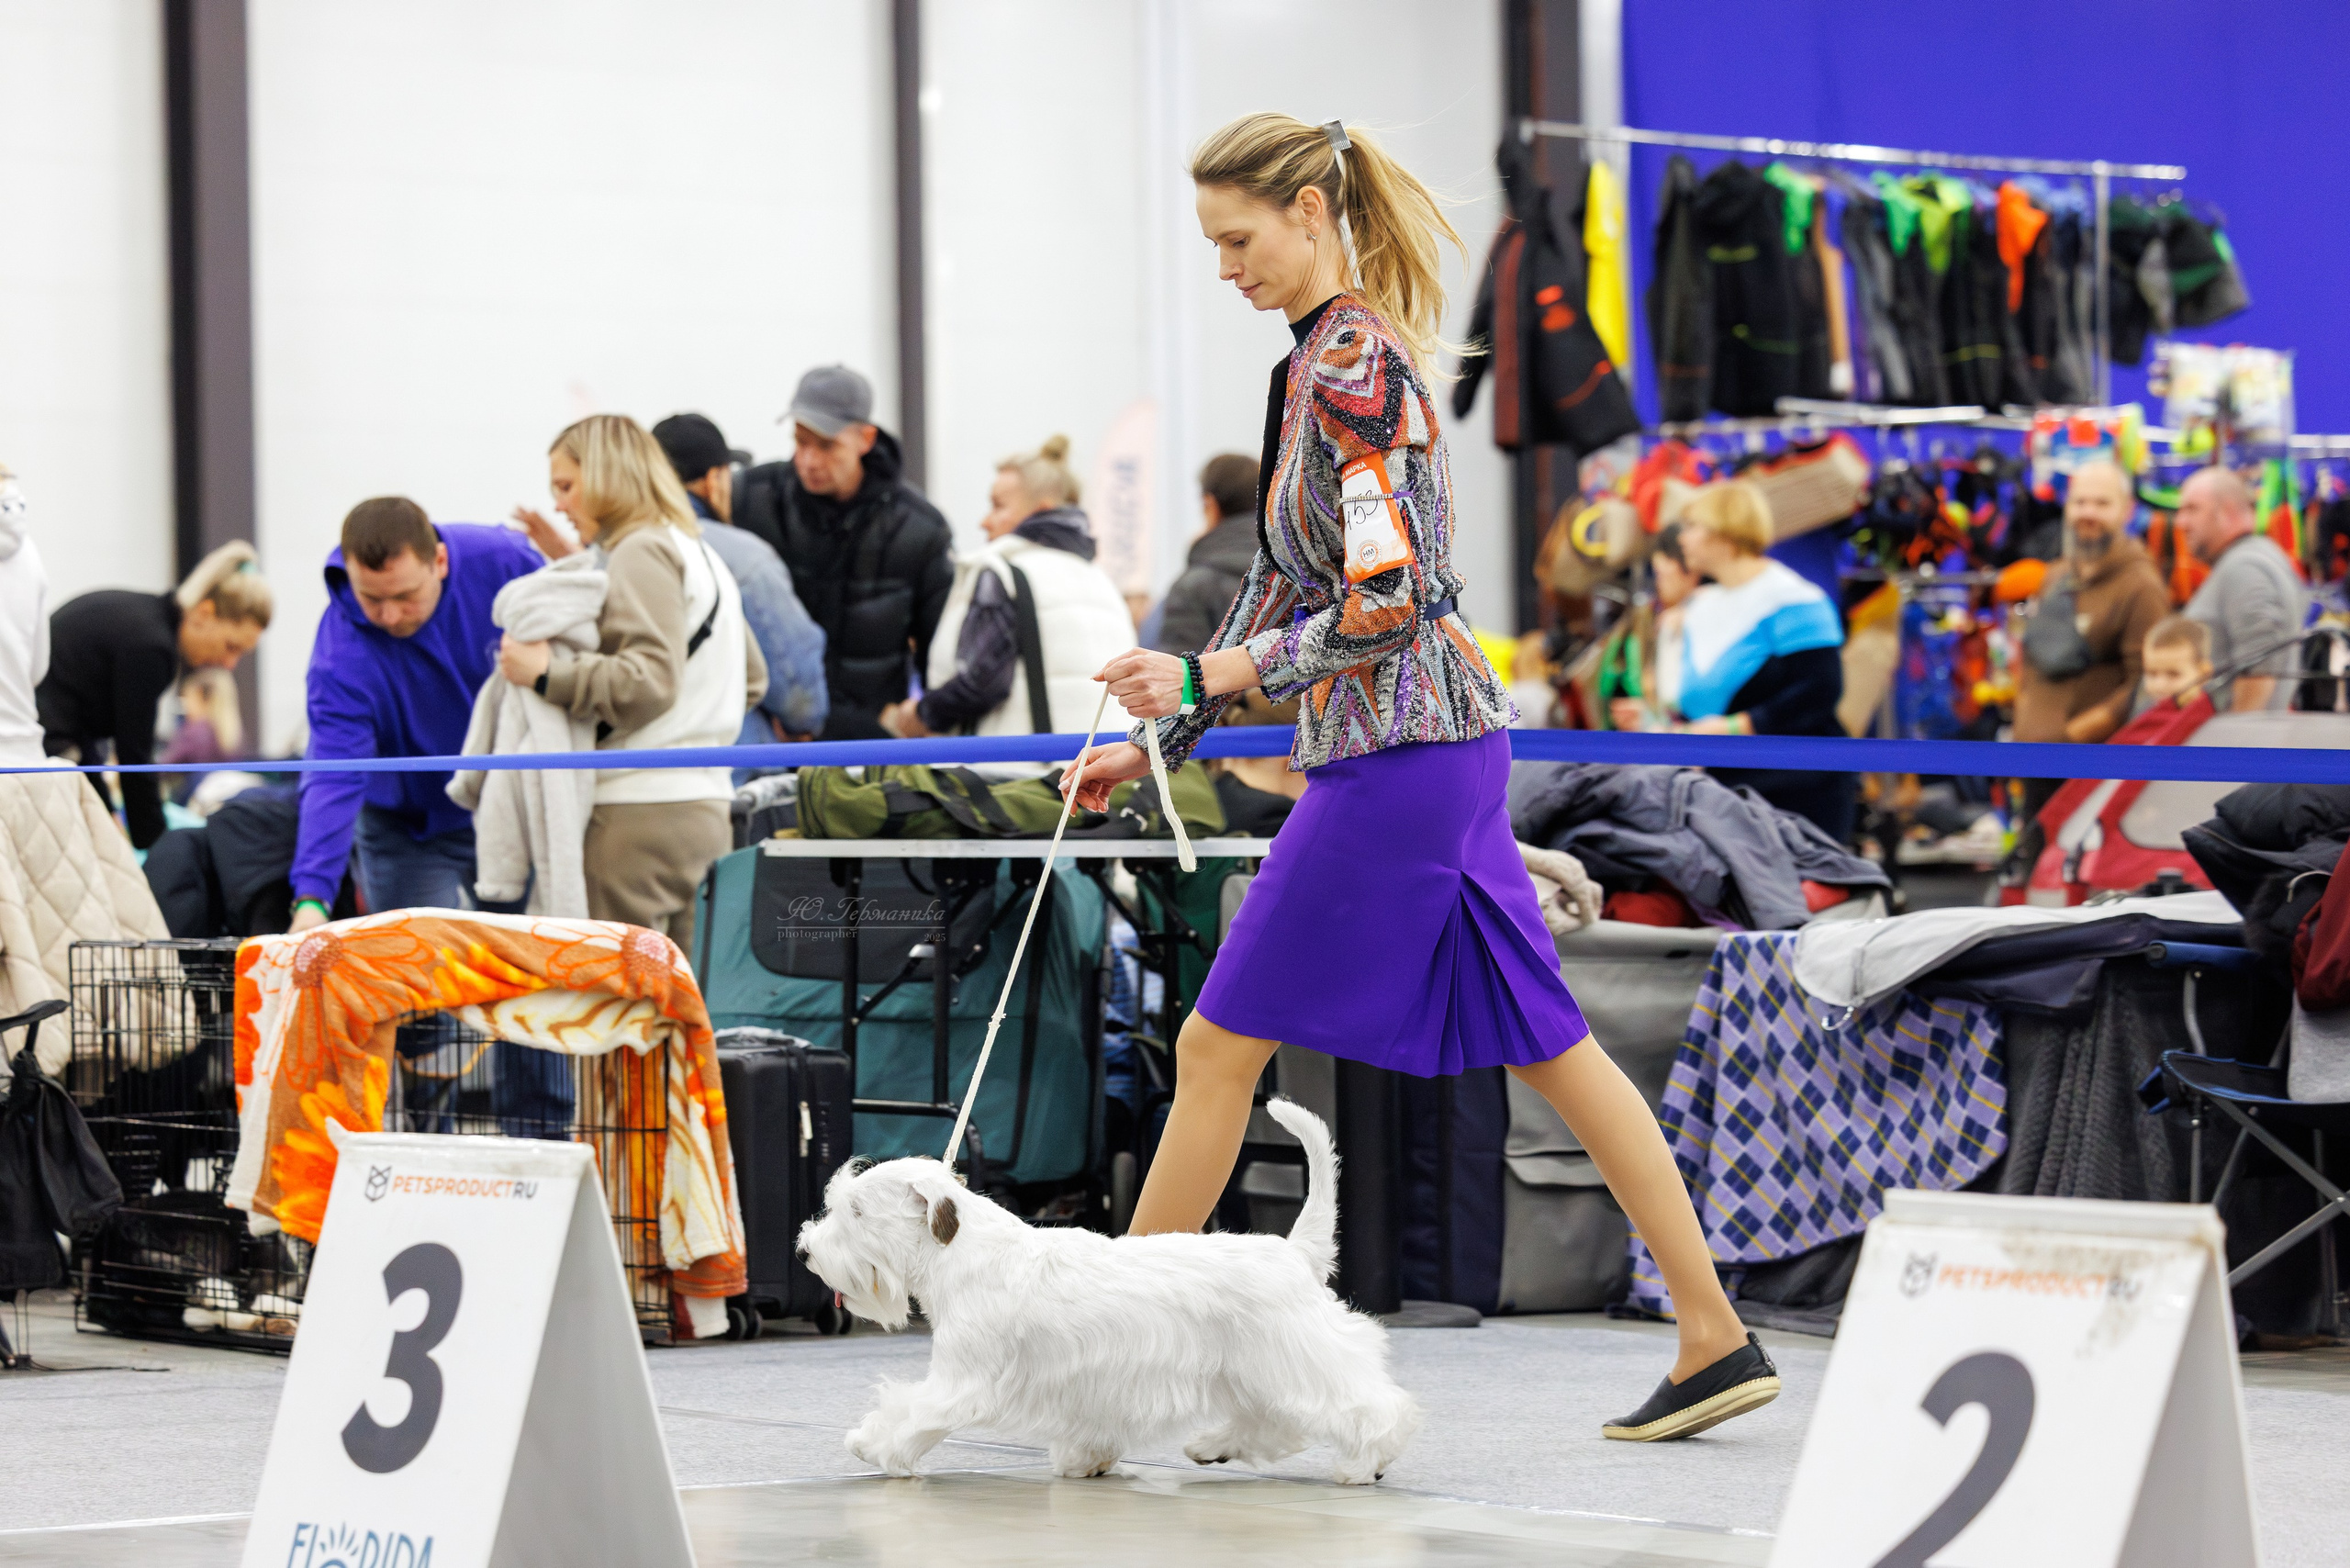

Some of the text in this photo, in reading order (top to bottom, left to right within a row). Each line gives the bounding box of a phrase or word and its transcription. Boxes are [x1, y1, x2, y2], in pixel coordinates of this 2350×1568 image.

[1345, 461, 1367, 476] МАРКА
[341, 1242, 464, 1473] 3
[1869, 1351, 2035, 1568] 2
